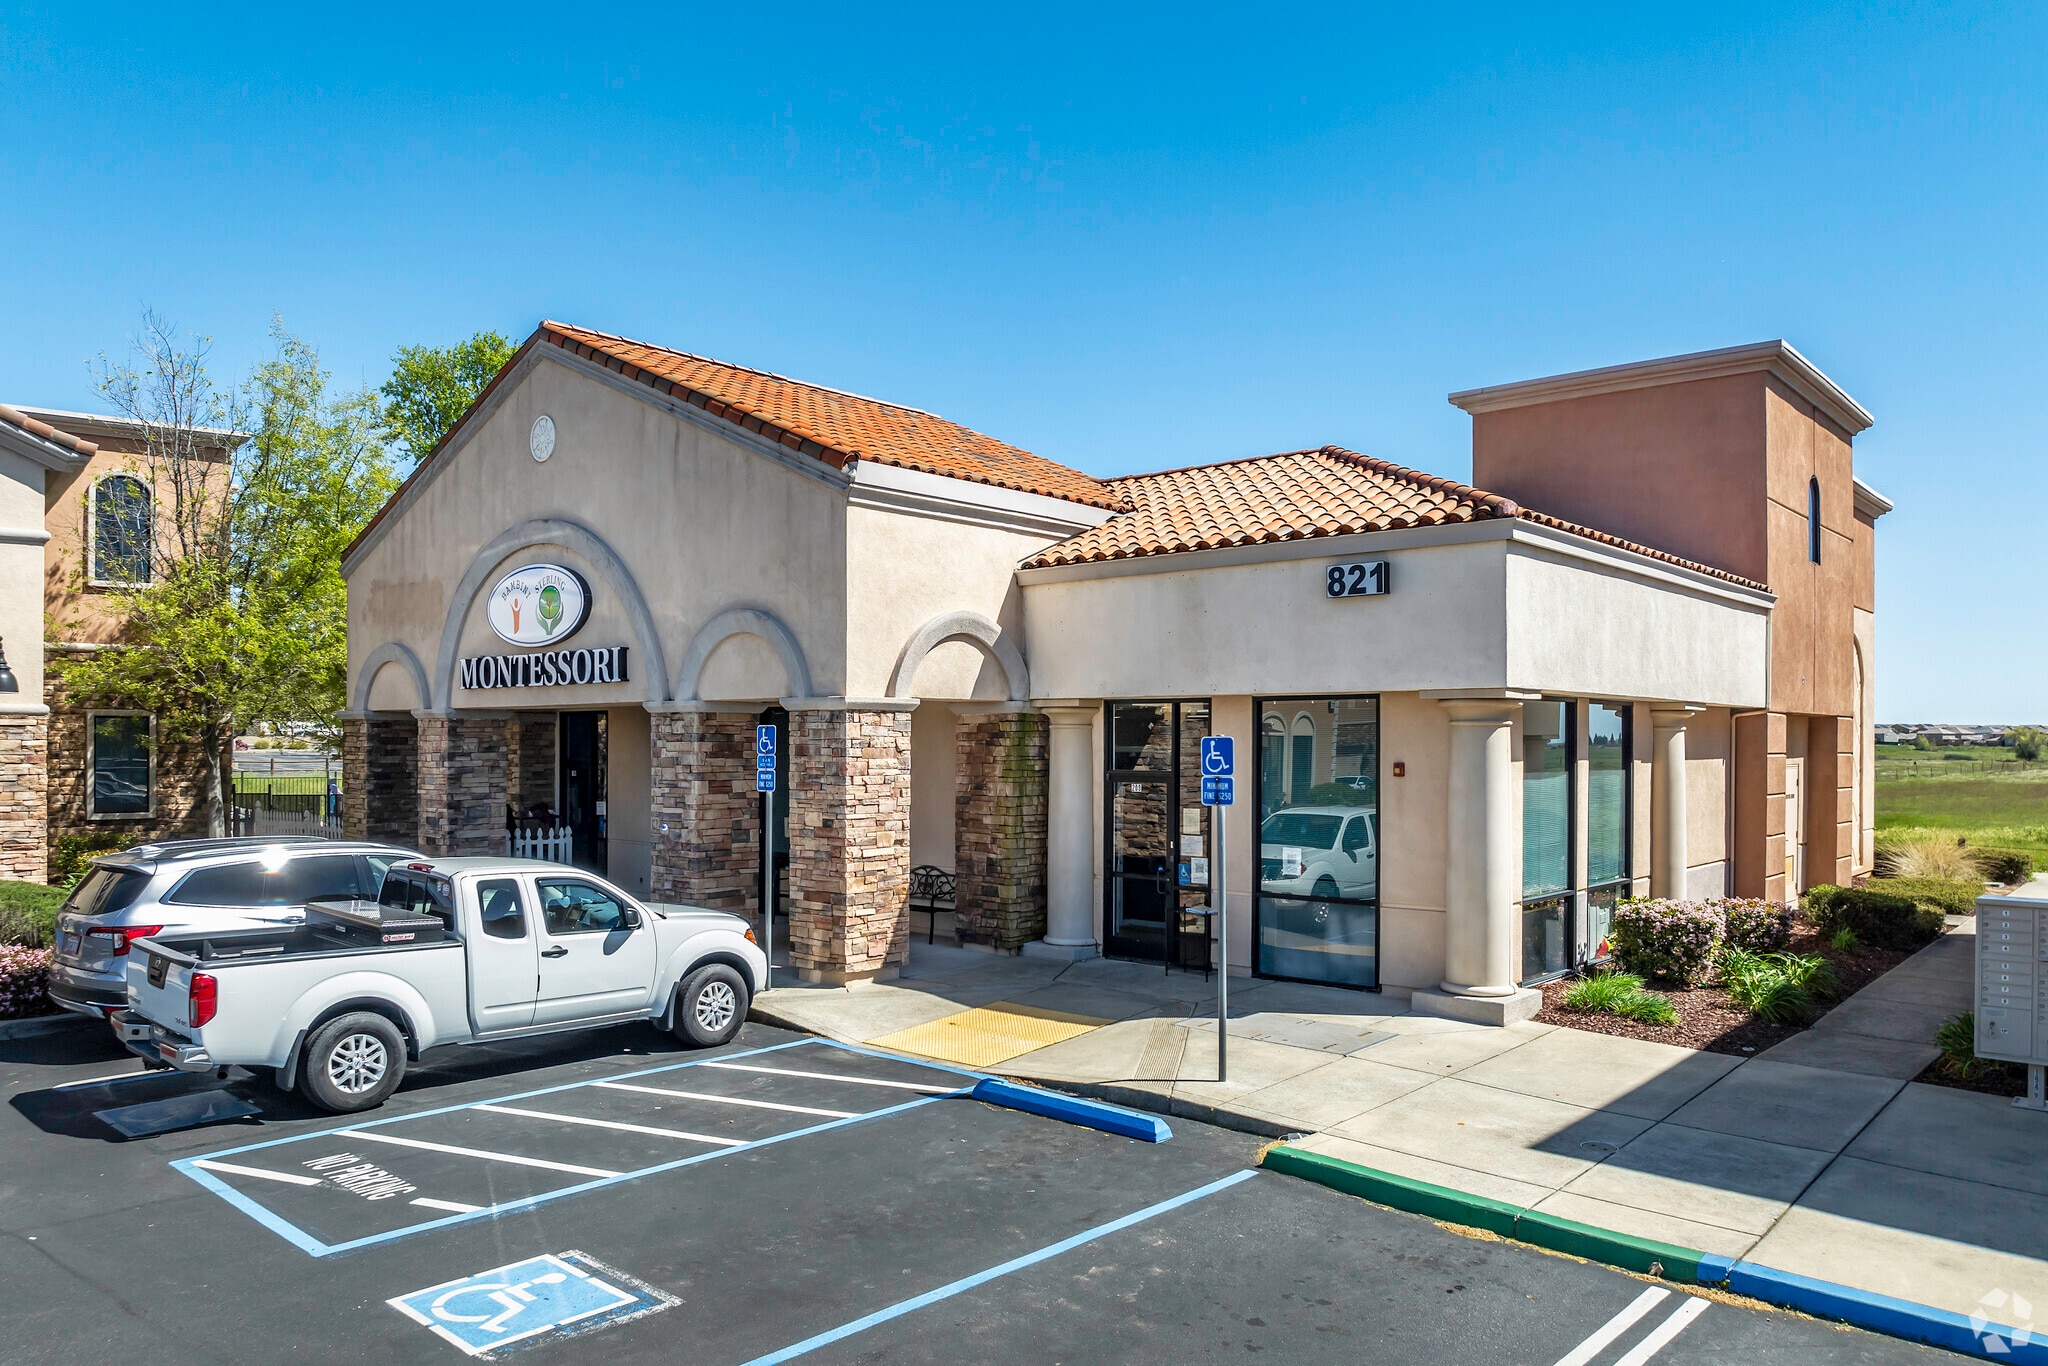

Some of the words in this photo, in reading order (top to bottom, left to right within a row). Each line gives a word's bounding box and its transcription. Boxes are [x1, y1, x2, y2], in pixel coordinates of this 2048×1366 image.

[501, 579, 531, 601] BAMBINI
[534, 574, 566, 594] STERLING
[1327, 562, 1384, 597] 821
[459, 646, 624, 690] MONTESSORI
[1203, 791, 1215, 800] FINE
[1206, 782, 1229, 790] MINMUM
[301, 1152, 361, 1171] NO
[322, 1162, 418, 1201] PARKING
